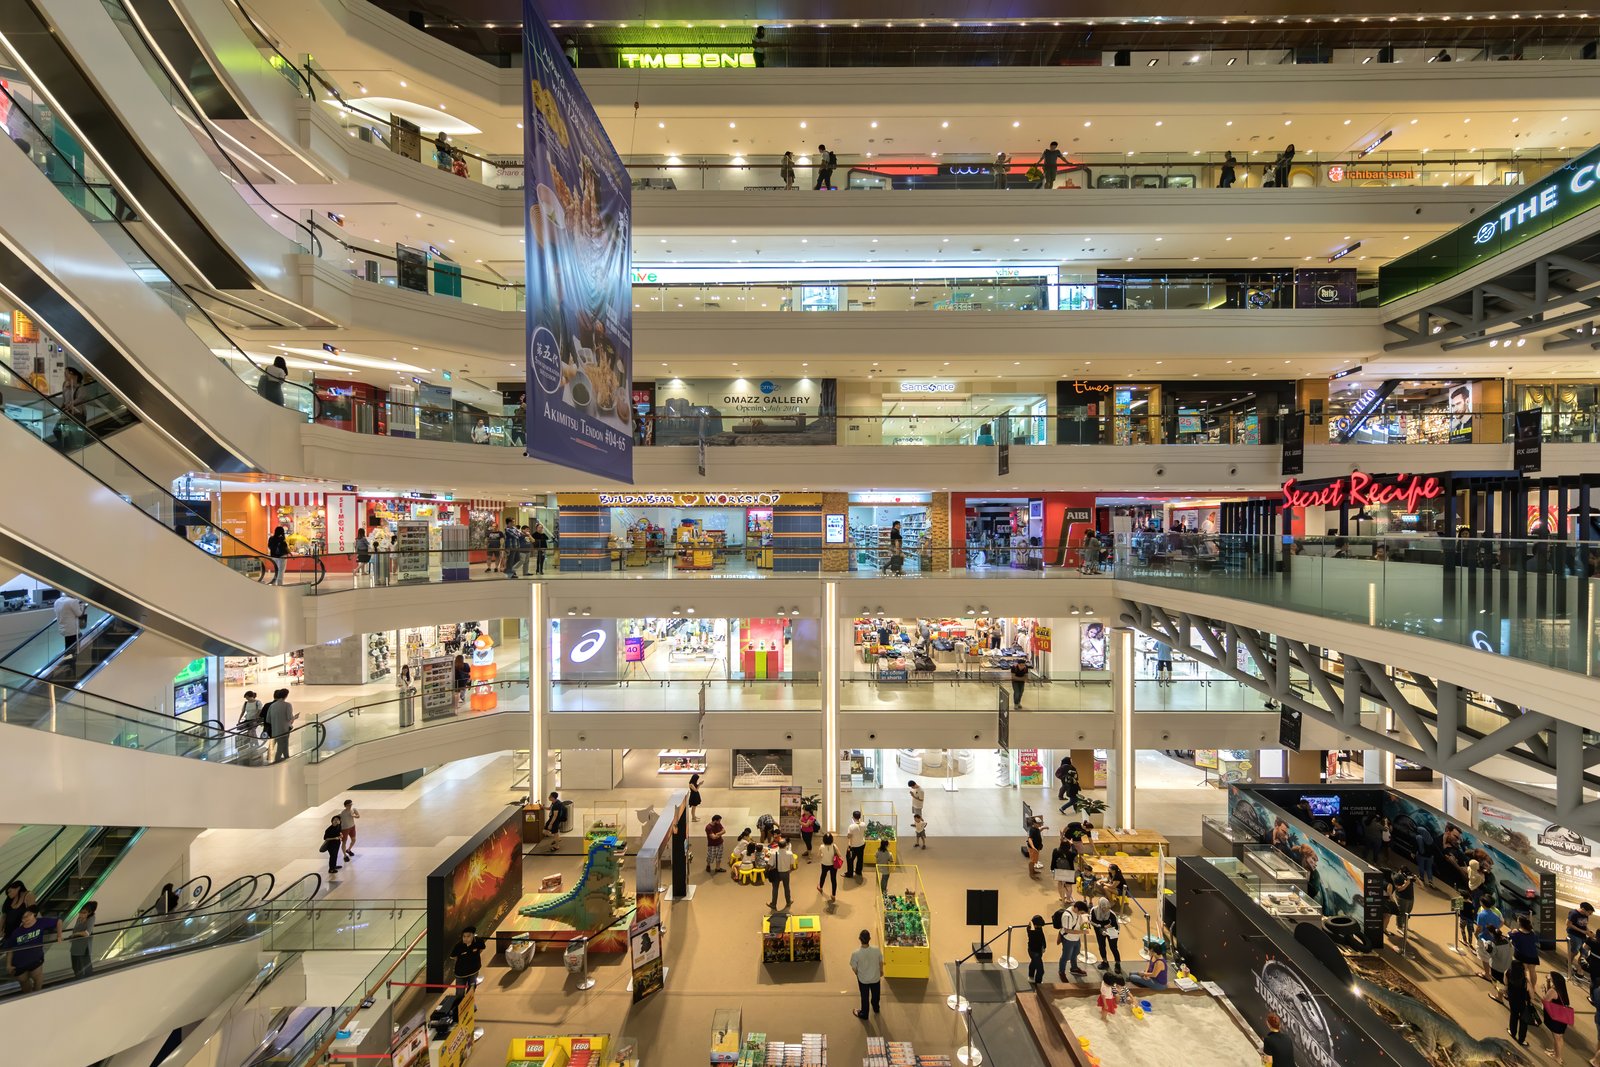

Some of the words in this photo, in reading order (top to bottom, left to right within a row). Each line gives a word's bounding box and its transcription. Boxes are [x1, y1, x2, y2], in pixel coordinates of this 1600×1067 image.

[621, 53, 756, 68] TIMEZONE
[1346, 168, 1385, 179] ichiban
[1388, 168, 1414, 179] sushi
[1500, 184, 1558, 232] THE
[1570, 161, 1600, 193] C
[901, 383, 954, 392] Samsonite
[1073, 377, 1112, 394] times
[724, 396, 760, 404] OMAZZ
[763, 396, 811, 404] GALLERY
[736, 404, 767, 413] Opening
[604, 429, 626, 452] #04-65
[1282, 478, 1344, 509] Secret
[1350, 471, 1445, 514] Recipe
[1066, 511, 1089, 520] AIBI
[1535, 857, 1564, 873] EXPLORE
[1573, 868, 1593, 880] ROAR
[1254, 975, 1297, 1034] JURASSIC
